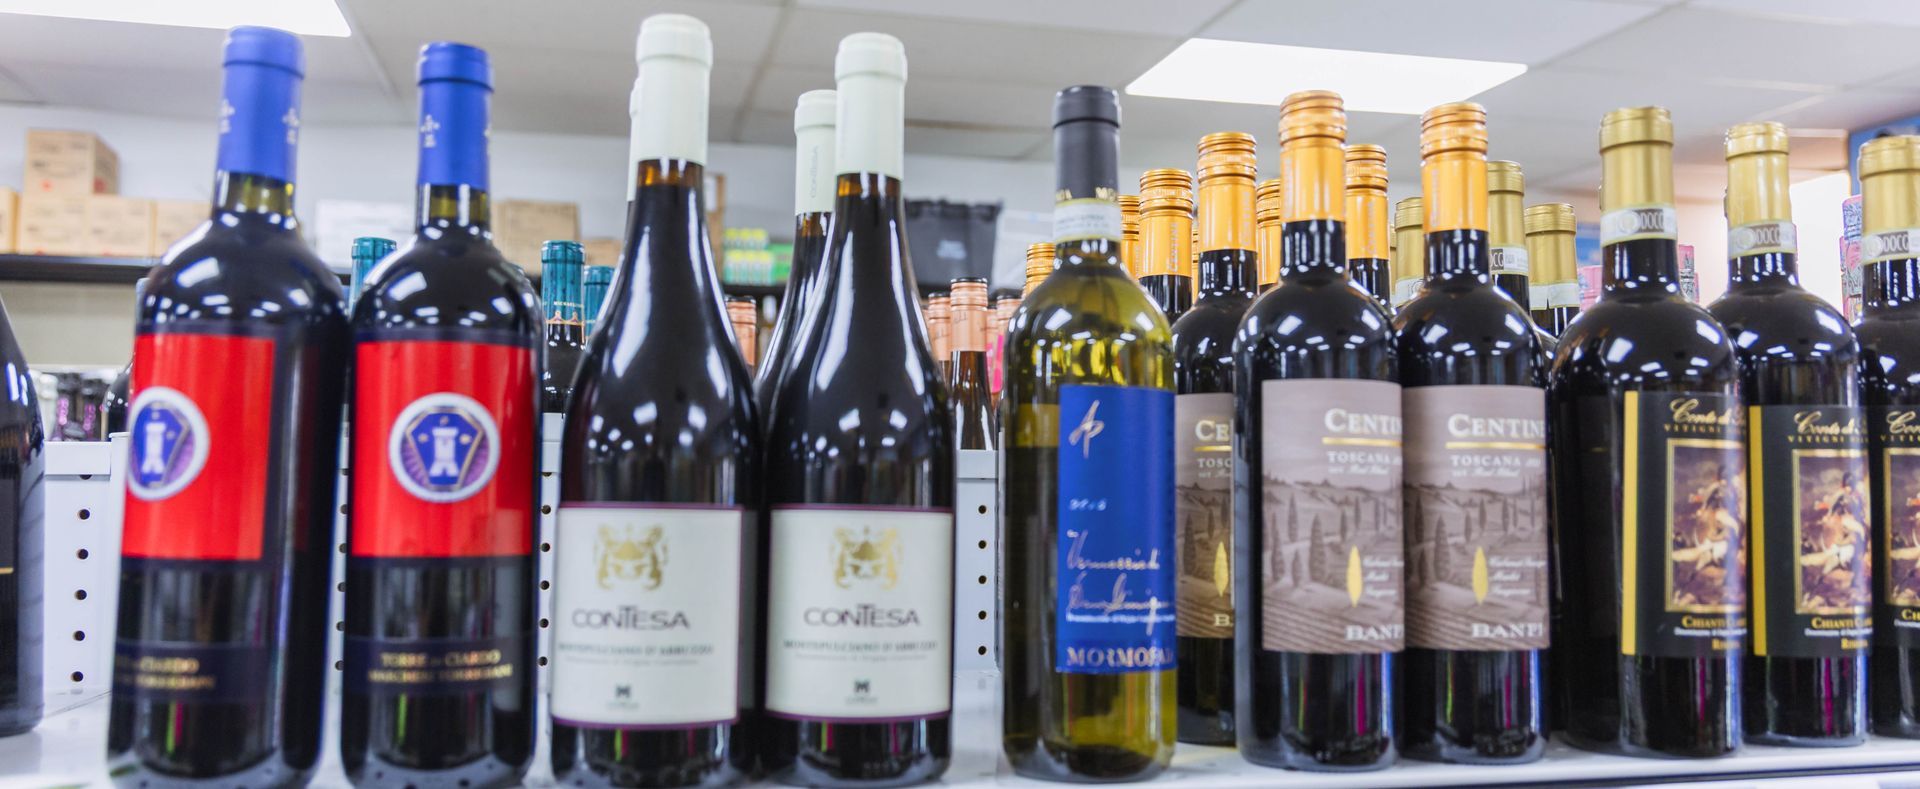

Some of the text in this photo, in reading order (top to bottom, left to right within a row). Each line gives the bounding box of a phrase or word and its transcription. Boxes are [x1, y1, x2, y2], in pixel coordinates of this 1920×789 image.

[1328, 450, 1390, 465] TOSCANA
[1450, 454, 1521, 467] TOSCANA
[572, 604, 691, 631] CONTESA
[803, 603, 920, 629] CONTESA
